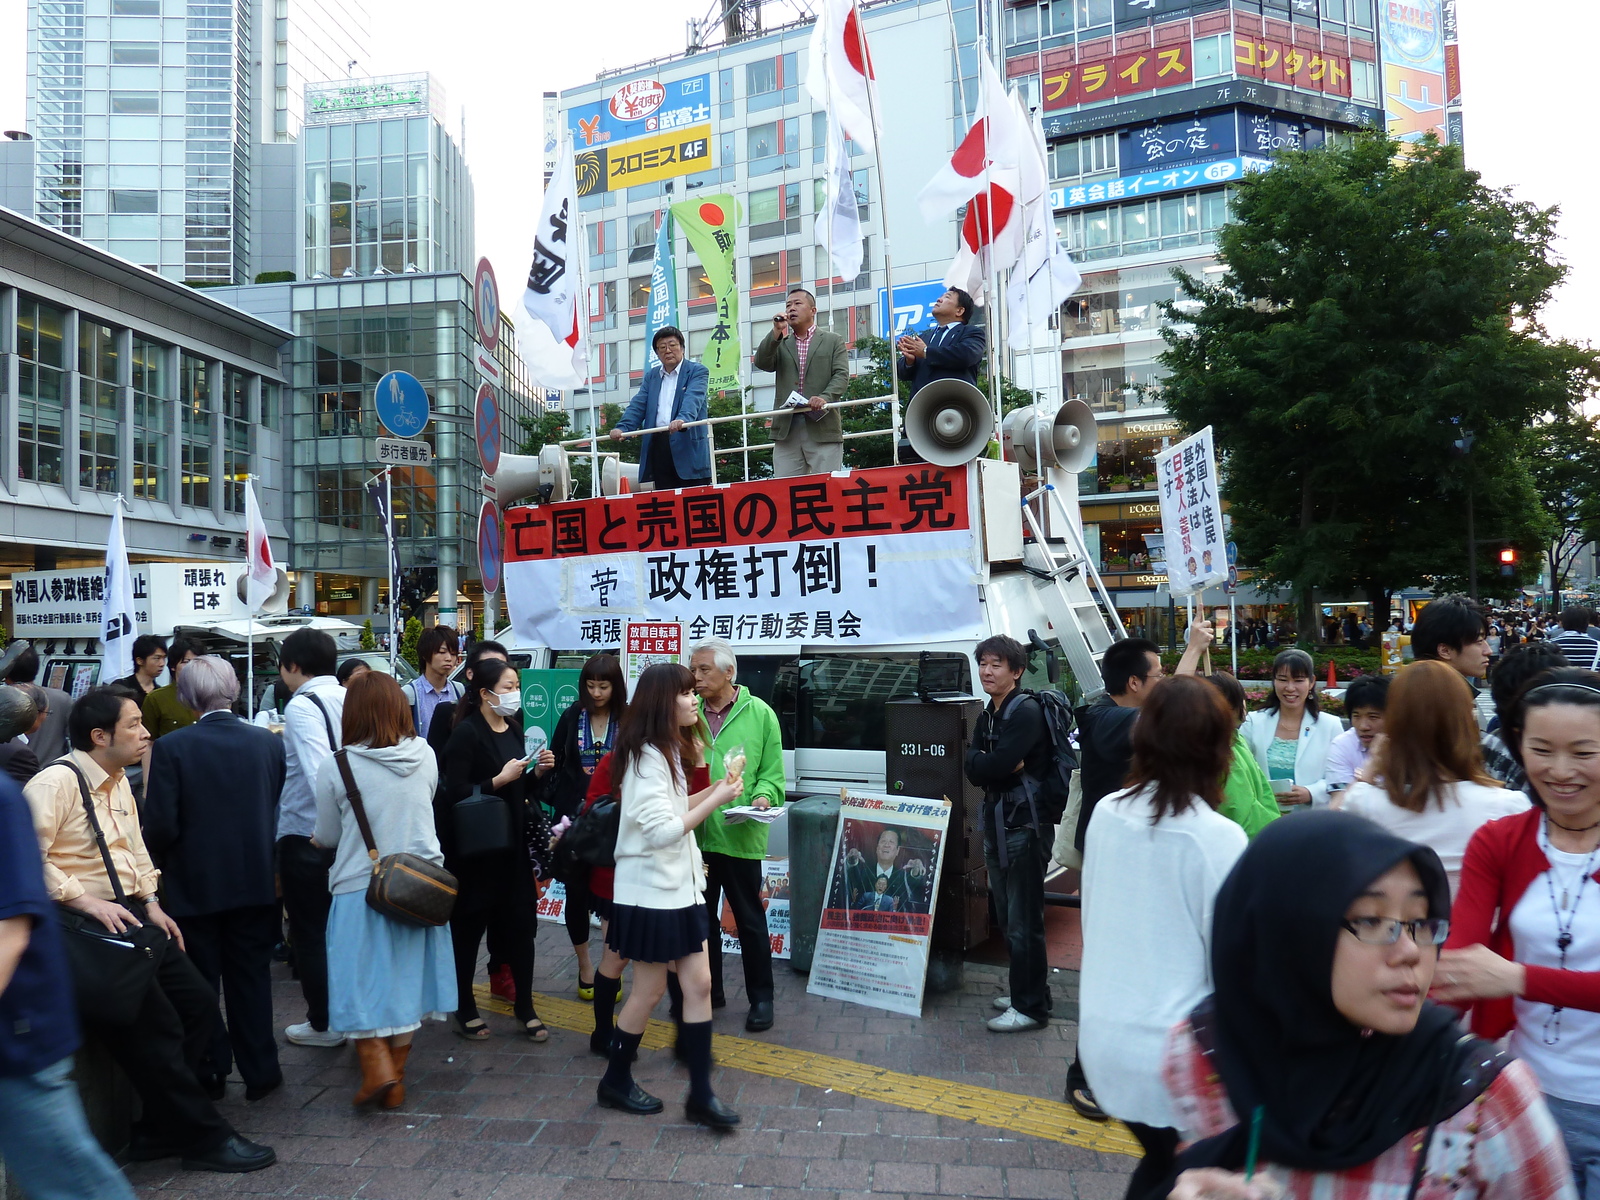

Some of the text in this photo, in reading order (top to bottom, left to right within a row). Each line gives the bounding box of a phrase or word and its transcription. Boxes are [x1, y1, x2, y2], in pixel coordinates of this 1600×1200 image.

[1388, 2, 1433, 30] EXILE
[1235, 39, 1346, 86] コンタクト
[1045, 48, 1186, 101] プライス
[312, 90, 420, 110] MARK CITY
[684, 82, 701, 95] 7F
[1217, 88, 1231, 100] 7F
[1246, 87, 1257, 98] 7F
[659, 103, 709, 130] 武富士
[1089, 112, 1114, 122] JAPANESE
[1116, 109, 1137, 117] DINING
[611, 141, 703, 177] プロミス 4F
[1069, 169, 1199, 206] 英会話イーオン
[1211, 166, 1229, 177] 6F
[547, 401, 559, 409] 5F
[381, 444, 428, 462] 歩行者優先
[1162, 458, 1174, 499] です
[511, 470, 956, 557] 亡国と売国の民主党
[184, 568, 227, 587] 頑張れ
[647, 541, 878, 602] 政権打倒！
[15, 572, 148, 604] 外国人参政権絶止
[590, 567, 618, 607] 菅
[194, 591, 220, 610] 日本
[581, 609, 862, 644] 頑張全国行動委員会
[629, 626, 679, 639] 放置自転車
[630, 639, 679, 652] 禁止区域
[901, 743, 945, 757] 331-06
